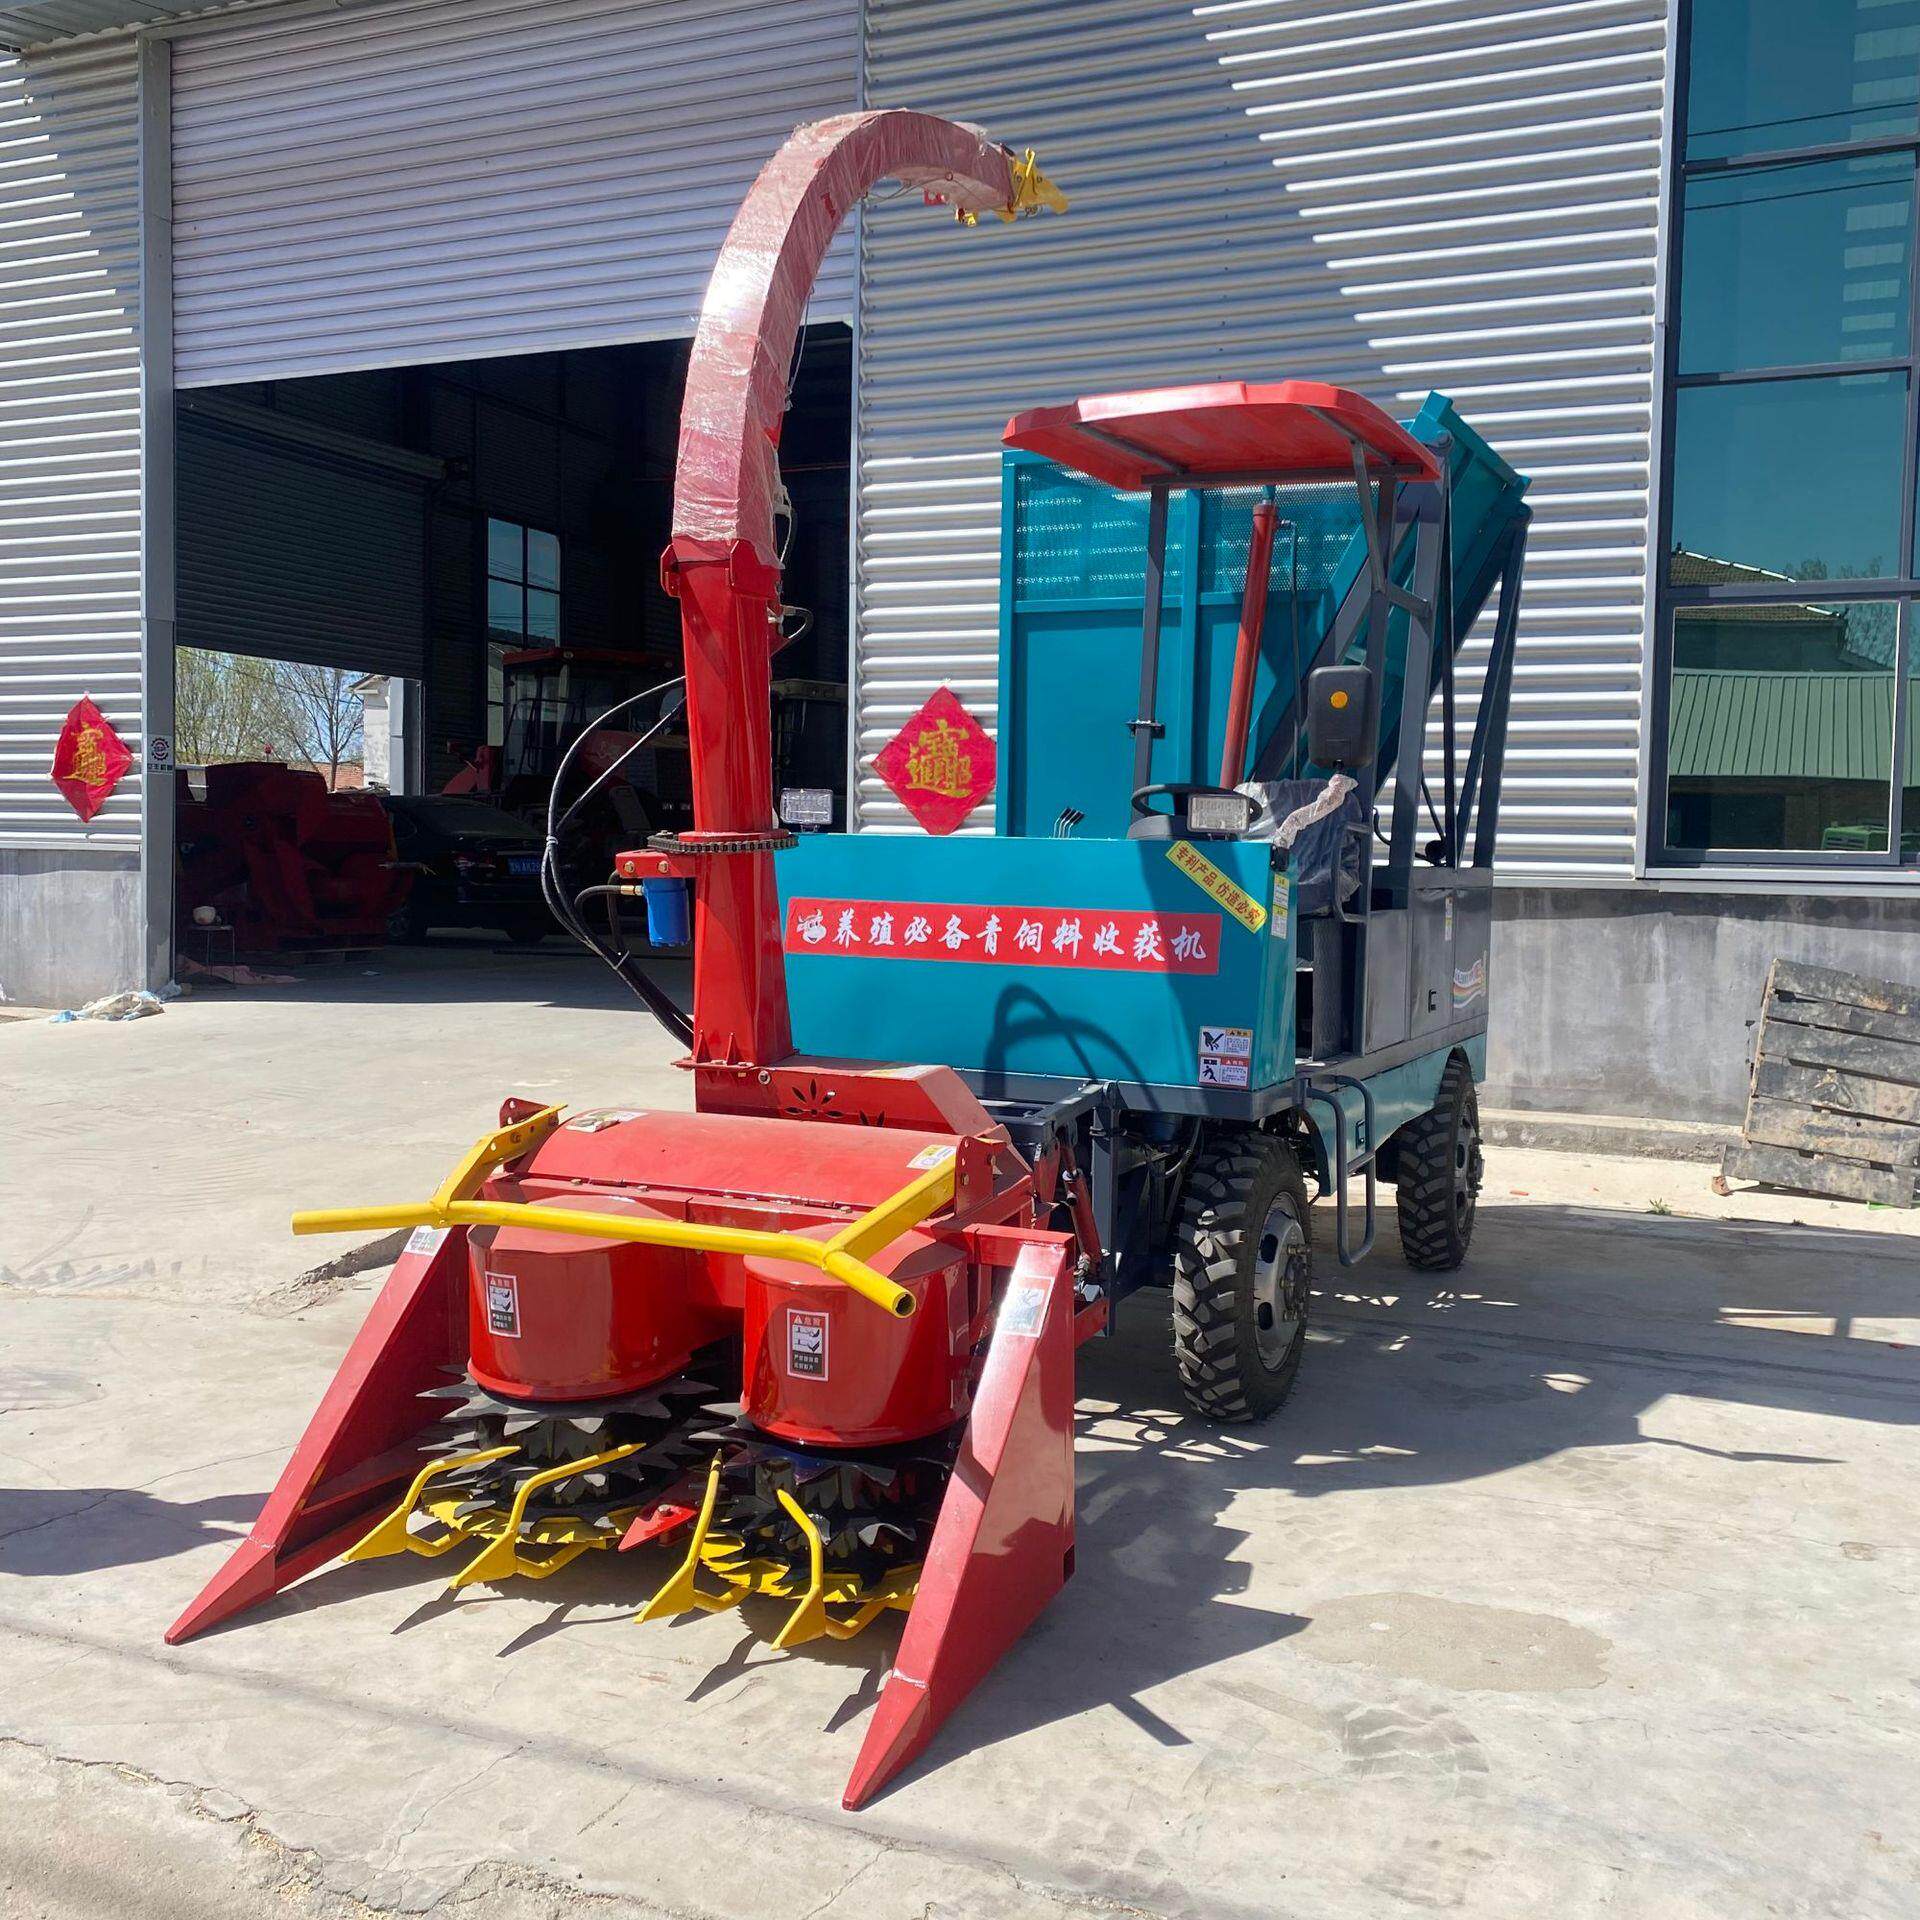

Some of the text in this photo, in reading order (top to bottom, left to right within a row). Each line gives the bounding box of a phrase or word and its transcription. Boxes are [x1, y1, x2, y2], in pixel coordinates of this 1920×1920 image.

[832, 906, 1207, 963] 养殖必备青饲料收获机
